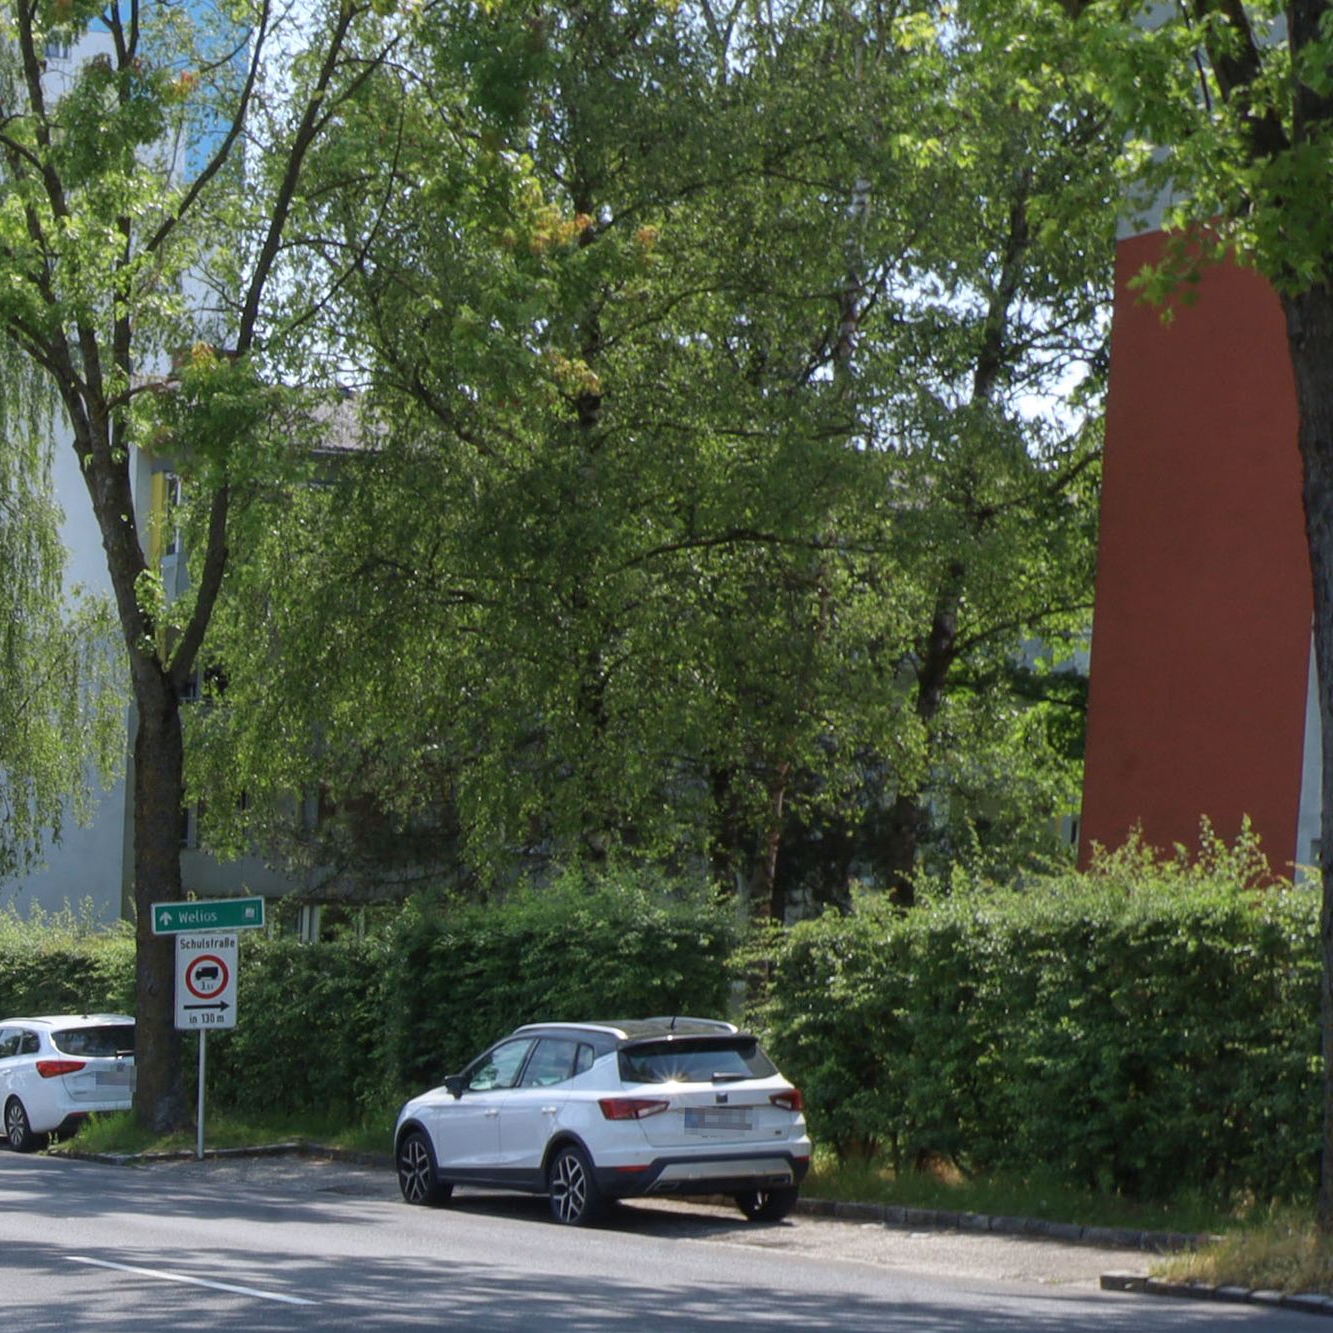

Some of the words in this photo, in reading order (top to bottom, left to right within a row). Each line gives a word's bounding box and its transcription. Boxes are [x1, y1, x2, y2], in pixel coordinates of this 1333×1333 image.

[178, 910, 218, 924] Welios
[180, 937, 235, 950] Schulstraße
[189, 1013, 198, 1024] in
[202, 1013, 215, 1024] 130
[217, 1014, 225, 1023] m
